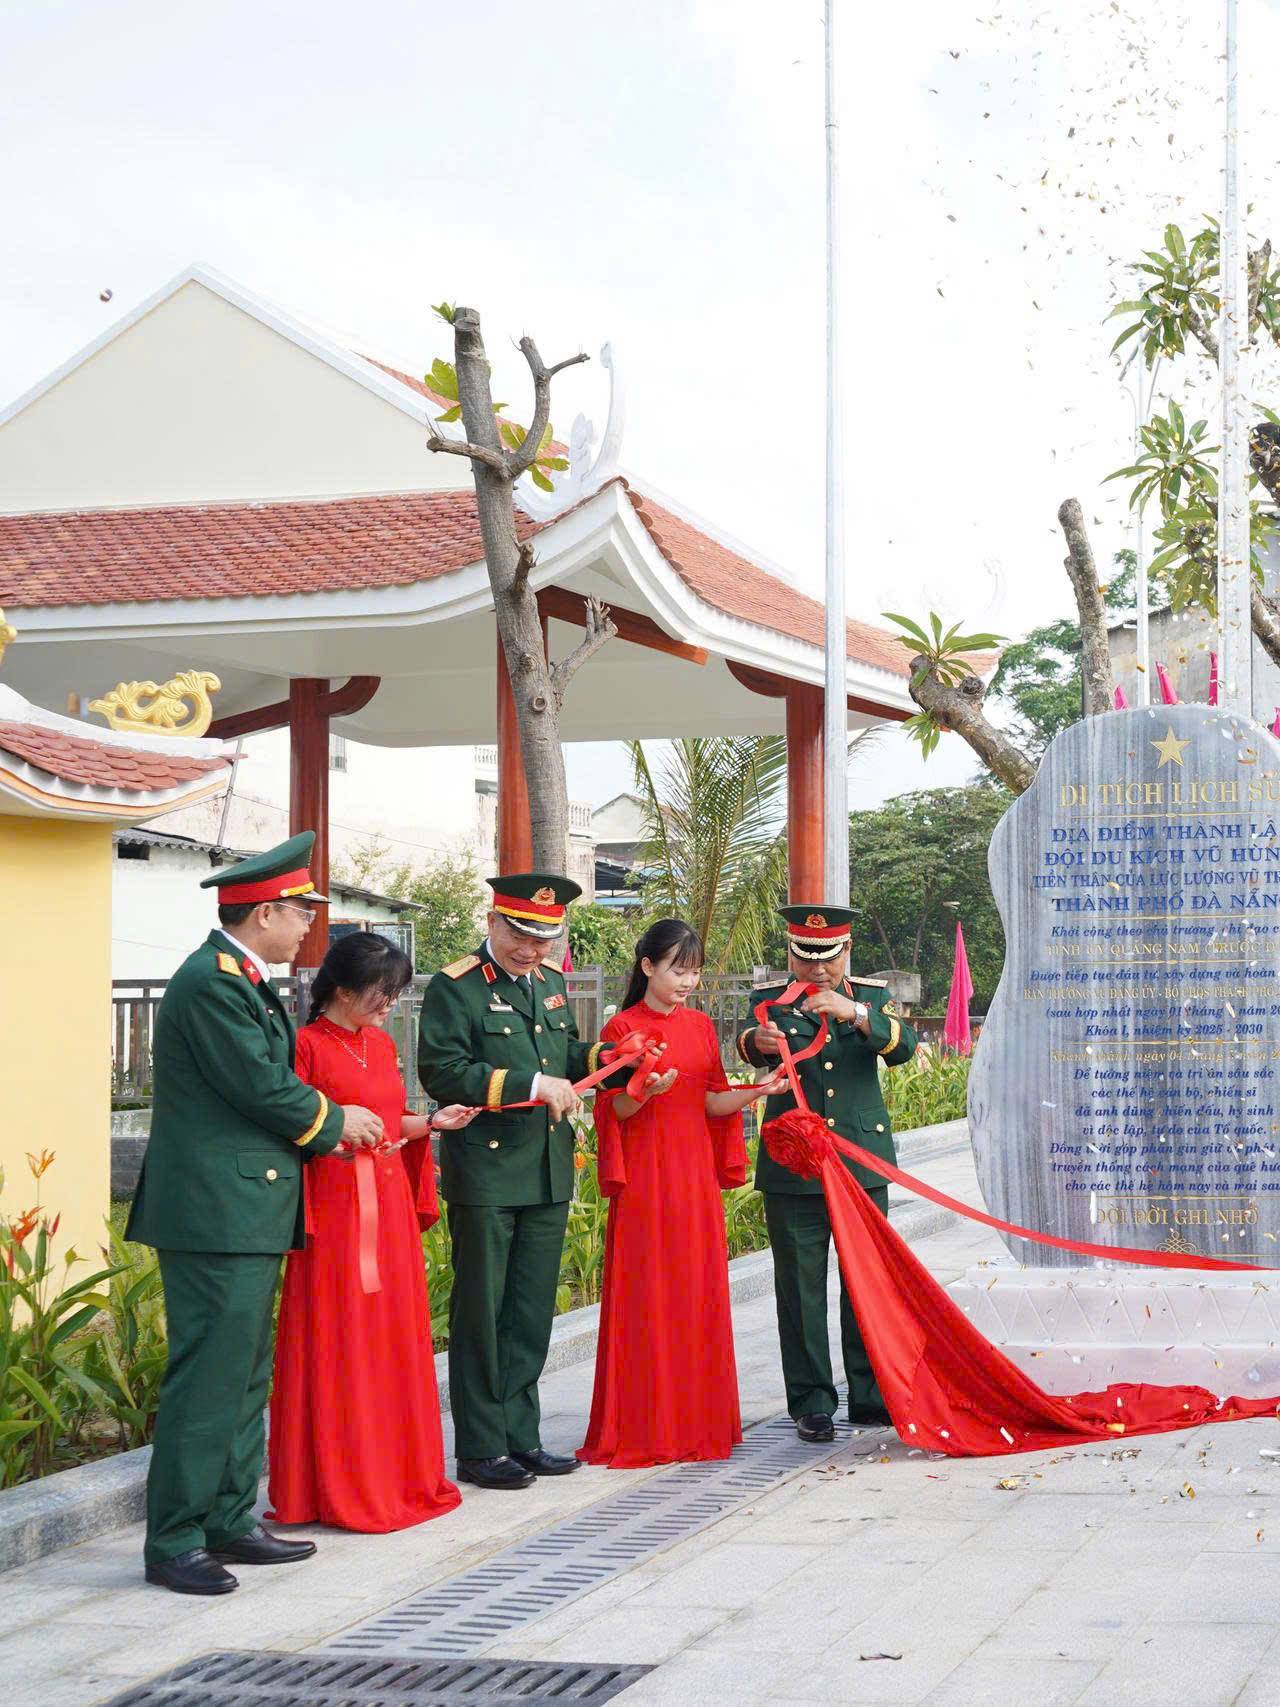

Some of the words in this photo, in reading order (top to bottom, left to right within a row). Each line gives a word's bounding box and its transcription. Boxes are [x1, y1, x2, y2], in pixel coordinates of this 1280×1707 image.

[1060, 783, 1088, 808] DI
[1097, 778, 1164, 807] TÍCH
[1172, 781, 1239, 809] LỊCH
[1051, 827, 1090, 845] ĐỊA
[1098, 819, 1155, 841] ĐIỂM
[1163, 821, 1242, 841] THÀNH
[1045, 848, 1084, 869] ĐỘI
[1091, 850, 1122, 866] DU
[1129, 846, 1186, 866] KÍCH
[1192, 845, 1223, 864] VŨ
[1115, 869, 1146, 887] CỦA
[1149, 870, 1180, 888] LỰC
[1184, 868, 1235, 888] LƯỢNG
[1240, 868, 1259, 884] VŨ
[1051, 893, 1130, 912] THÀNH
[1136, 889, 1185, 912] PHỐ
[1191, 891, 1223, 910] ĐÀ
[1051, 925, 1081, 938] Khởi
[1083, 925, 1113, 939] công
[1116, 924, 1143, 937] theo
[1168, 942, 1201, 954] NAM
[1030, 969, 1061, 984] Được
[1064, 969, 1089, 985] tiếp
[1225, 967, 1241, 980] và
[1244, 966, 1275, 979] hoàn
[1046, 1007, 1072, 1019] (sau
[1075, 1006, 1099, 1020] hợp
[1102, 1004, 1132, 1018] nhất
[1085, 1024, 1118, 1037] Khóa
[1134, 1023, 1173, 1038] nhiệm
[1195, 1023, 1224, 1036] 2025
[1235, 1023, 1264, 1035] 2030
[1073, 1067, 1093, 1080] Để
[1187, 1067, 1204, 1079] tri
[1091, 1086, 1113, 1099] các
[1116, 1086, 1138, 1099] thế
[1095, 1105, 1119, 1118] anh
[1157, 1103, 1193, 1118] hiến
[1246, 1103, 1275, 1117] sinh
[1123, 1123, 1148, 1138] lập,
[1168, 1123, 1184, 1136] do
[1187, 1123, 1210, 1135] của
[1234, 1121, 1268, 1138] quốc.
[1114, 1142, 1138, 1157] góp
[1207, 1161, 1231, 1173] của
[1234, 1160, 1257, 1175] quê
[1065, 1180, 1087, 1192] cho
[1090, 1180, 1111, 1192] các
[1115, 1180, 1137, 1192] thế
[1139, 1180, 1153, 1193] hệ
[1158, 1180, 1186, 1192] hôm
[1188, 1181, 1211, 1194] nay
[1215, 1180, 1230, 1191] và
[1234, 1180, 1258, 1191] mai
[1133, 1203, 1170, 1225] ĐỜI
[1174, 1208, 1210, 1225] GHI
